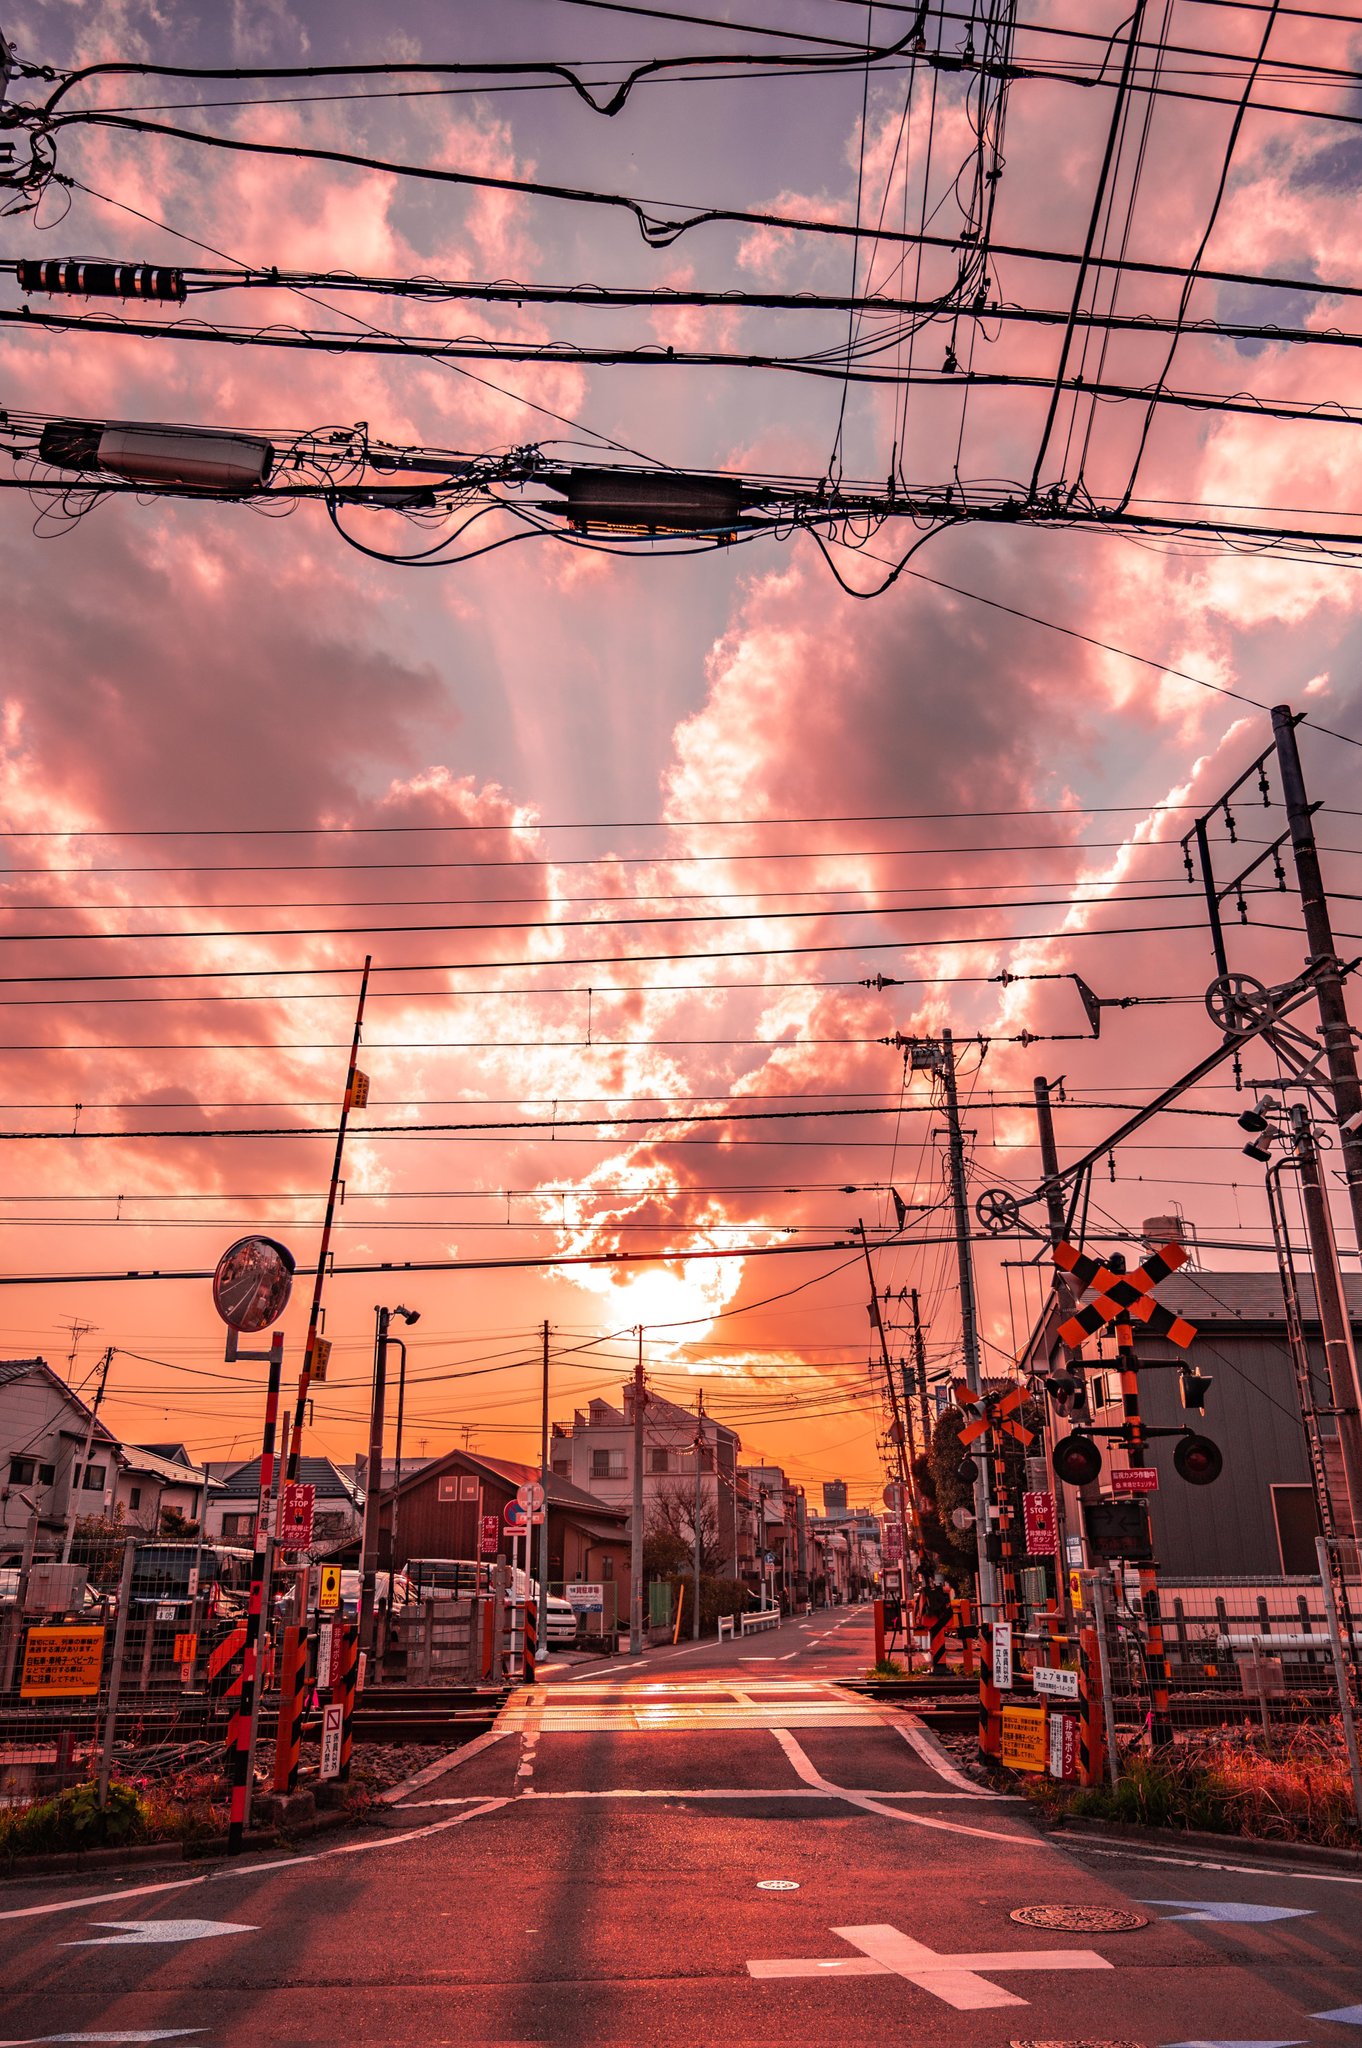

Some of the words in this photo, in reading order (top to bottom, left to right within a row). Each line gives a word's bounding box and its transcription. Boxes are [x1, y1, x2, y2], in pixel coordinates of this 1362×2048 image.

[1112, 1471, 1155, 1479] 監視カメラ作動中
[332, 1628, 341, 1682] 非常ボタン
[323, 1734, 331, 1773] 立入禁止
[1065, 1720, 1073, 1775] 非常ボタン
